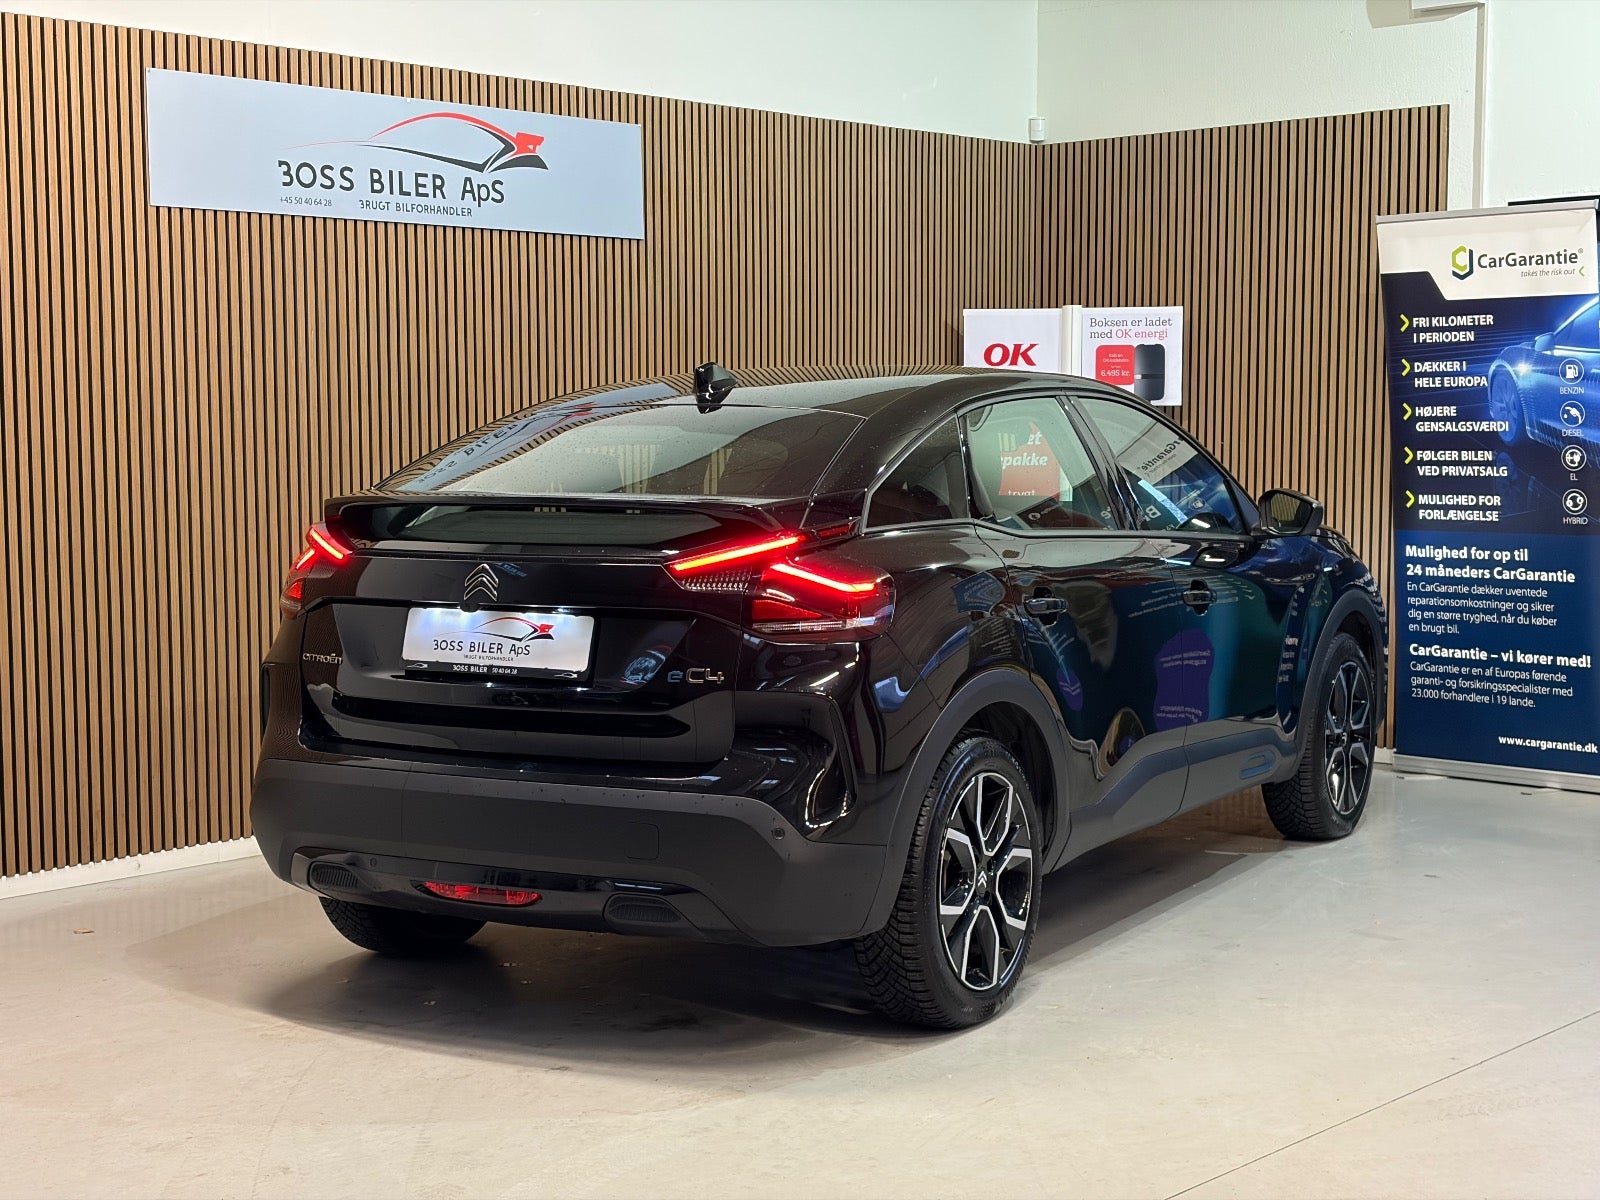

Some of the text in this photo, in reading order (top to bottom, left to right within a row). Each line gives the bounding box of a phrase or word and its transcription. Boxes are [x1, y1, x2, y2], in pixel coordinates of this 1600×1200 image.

[370, 168, 446, 199] BILER
[460, 176, 504, 207] ApS
[396, 202, 472, 217] BILFORHANDLER
[1521, 269, 1538, 278] takes
[1539, 268, 1550, 276] the
[1551, 268, 1563, 276] risk
[1090, 317, 1172, 327] Boksen er ladet
[1413, 315, 1494, 328] FRI KILOMETER
[1090, 329, 1168, 340] med OK energi
[1414, 331, 1474, 343] I PERIODEN
[984, 343, 1039, 366] OK
[1414, 361, 1466, 372] DÆKKER I
[1415, 377, 1488, 387] HELE EUROPA
[1416, 406, 1456, 417] HØJERE
[1416, 421, 1509, 432] GENSALGSVÆRDI
[1417, 450, 1492, 461] FØLGER BILEN
[1417, 466, 1507, 476] VED PRIVATSALG
[1419, 495, 1501, 506] MULIGHED FOR
[1419, 510, 1499, 521] FORLÆNGELSE
[1406, 545, 1528, 563] Mulighed for op til
[1406, 564, 1576, 583] 24 måneders CarGarantie
[1407, 582, 1548, 598] En CarGarantie dækker uventede
[1408, 597, 1554, 612] reparationsomkostninger og sikrer
[1408, 609, 1422, 620] dig
[1437, 611, 1460, 620] større
[1463, 612, 1499, 624] tryghed,
[1501, 614, 1515, 624] når
[1517, 616, 1529, 625] du
[1531, 616, 1557, 626] køber
[1422, 623, 1445, 635] brugt
[1447, 624, 1459, 634] bil.
[469, 641, 503, 654] BILER
[509, 644, 531, 657] ApS
[1410, 644, 1487, 660] CarGarantie
[1501, 650, 1513, 662] vi
[1517, 651, 1553, 665] kører
[1556, 654, 1591, 668] med!
[1410, 661, 1459, 674] CarGarantie
[1472, 668, 1482, 676] en
[1485, 667, 1494, 676] af
[1495, 668, 1529, 680] Europas
[1532, 670, 1567, 682] førende
[1411, 675, 1573, 696] garanti- og forsikringsspecialister med
[1412, 688, 1439, 698] 23.000
[1441, 690, 1490, 704] forhandlere
[1497, 695, 1507, 704] 19
[1509, 697, 1536, 708] lande.
[1499, 736, 1598, 754] www.cargarantie.dk
